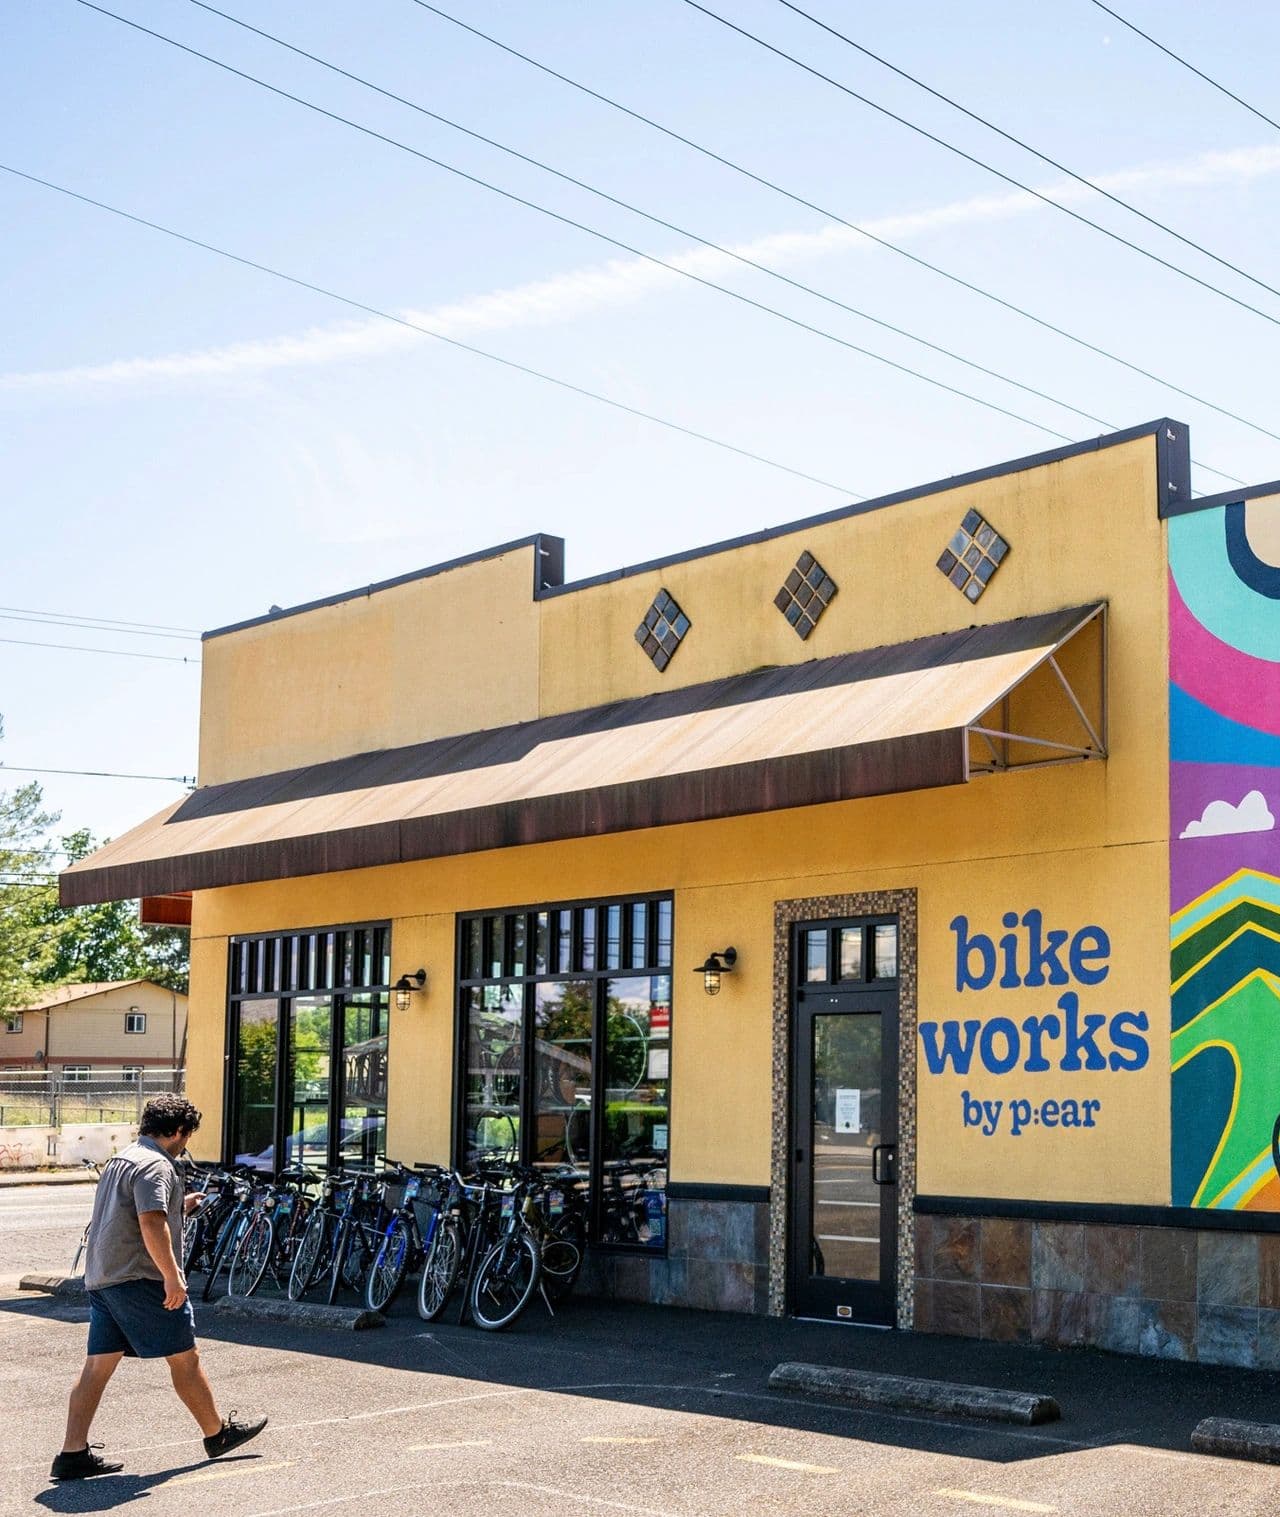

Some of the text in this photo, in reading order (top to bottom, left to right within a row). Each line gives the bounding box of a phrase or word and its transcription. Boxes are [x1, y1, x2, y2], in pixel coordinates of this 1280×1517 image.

[950, 909, 1111, 991] bike
[918, 992, 1150, 1075] works
[961, 1090, 1101, 1137] by p:ear
